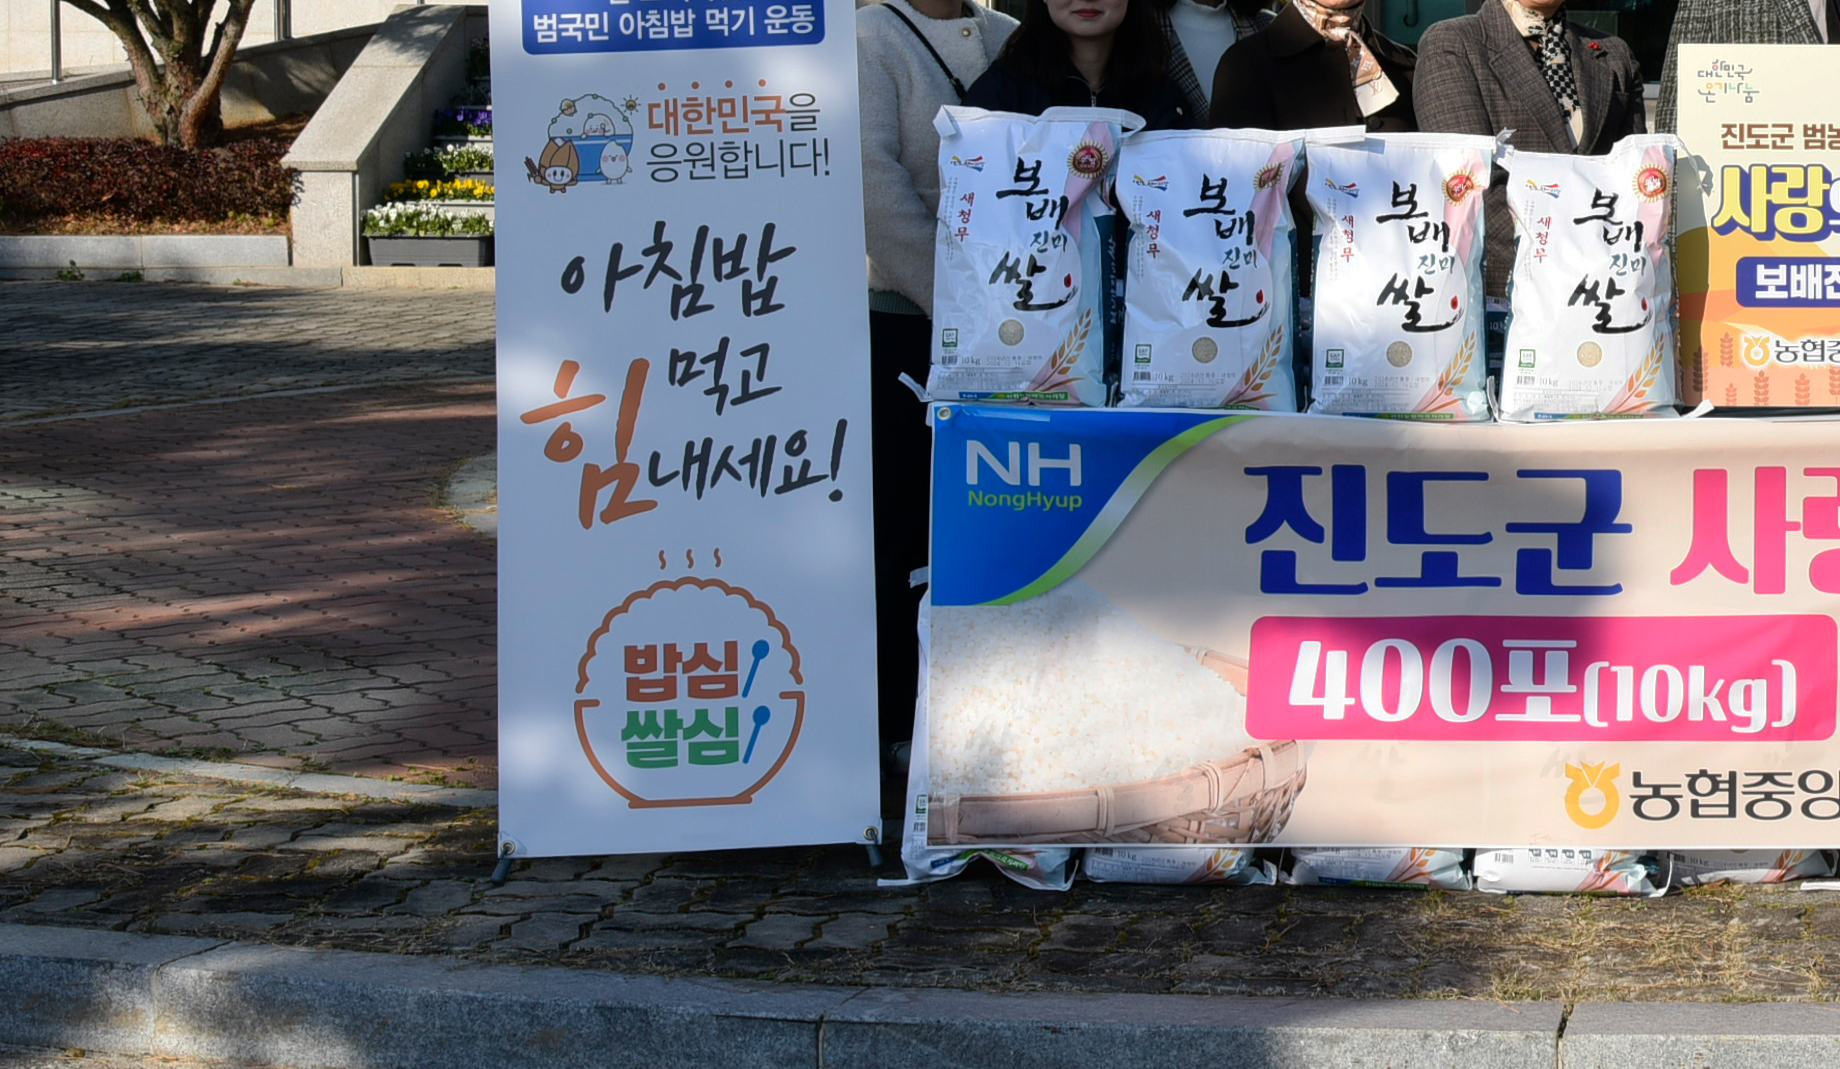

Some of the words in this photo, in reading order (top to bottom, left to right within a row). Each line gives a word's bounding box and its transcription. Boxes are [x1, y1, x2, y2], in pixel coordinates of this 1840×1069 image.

[534, 12, 608, 42] 범국민
[619, 9, 695, 39] 아침밥
[706, 6, 754, 36] 먹기
[764, 5, 815, 34] 운동
[1697, 58, 1752, 81] 대한민국
[1697, 82, 1760, 103] 온기나눔
[647, 92, 820, 136] 대한민국을
[1722, 124, 1794, 149] 진도군
[647, 138, 828, 182] 응원합니다!
[953, 191, 976, 243] 새청무
[1029, 230, 1068, 254] 진미
[1221, 246, 1258, 269] 진미
[1417, 255, 1455, 276] 진미
[1609, 254, 1647, 276] 진미
[560, 221, 796, 320] 아침밥
[989, 251, 1075, 312] 쌀
[1181, 267, 1267, 328] 쌀
[1376, 273, 1461, 333] 쌀
[1568, 273, 1651, 334] 쌀
[668, 336, 783, 416] 먹고
[520, 358, 659, 529] 힘
[648, 419, 849, 502] 내세요!
[967, 440, 1082, 486] NH
[968, 490, 1083, 511] NongHyup
[1244, 464, 1632, 595] 진도군
[624, 641, 738, 702] 밥심
[1288, 638, 1797, 733] 400포(10kg)
[622, 707, 739, 768] 쌀심
